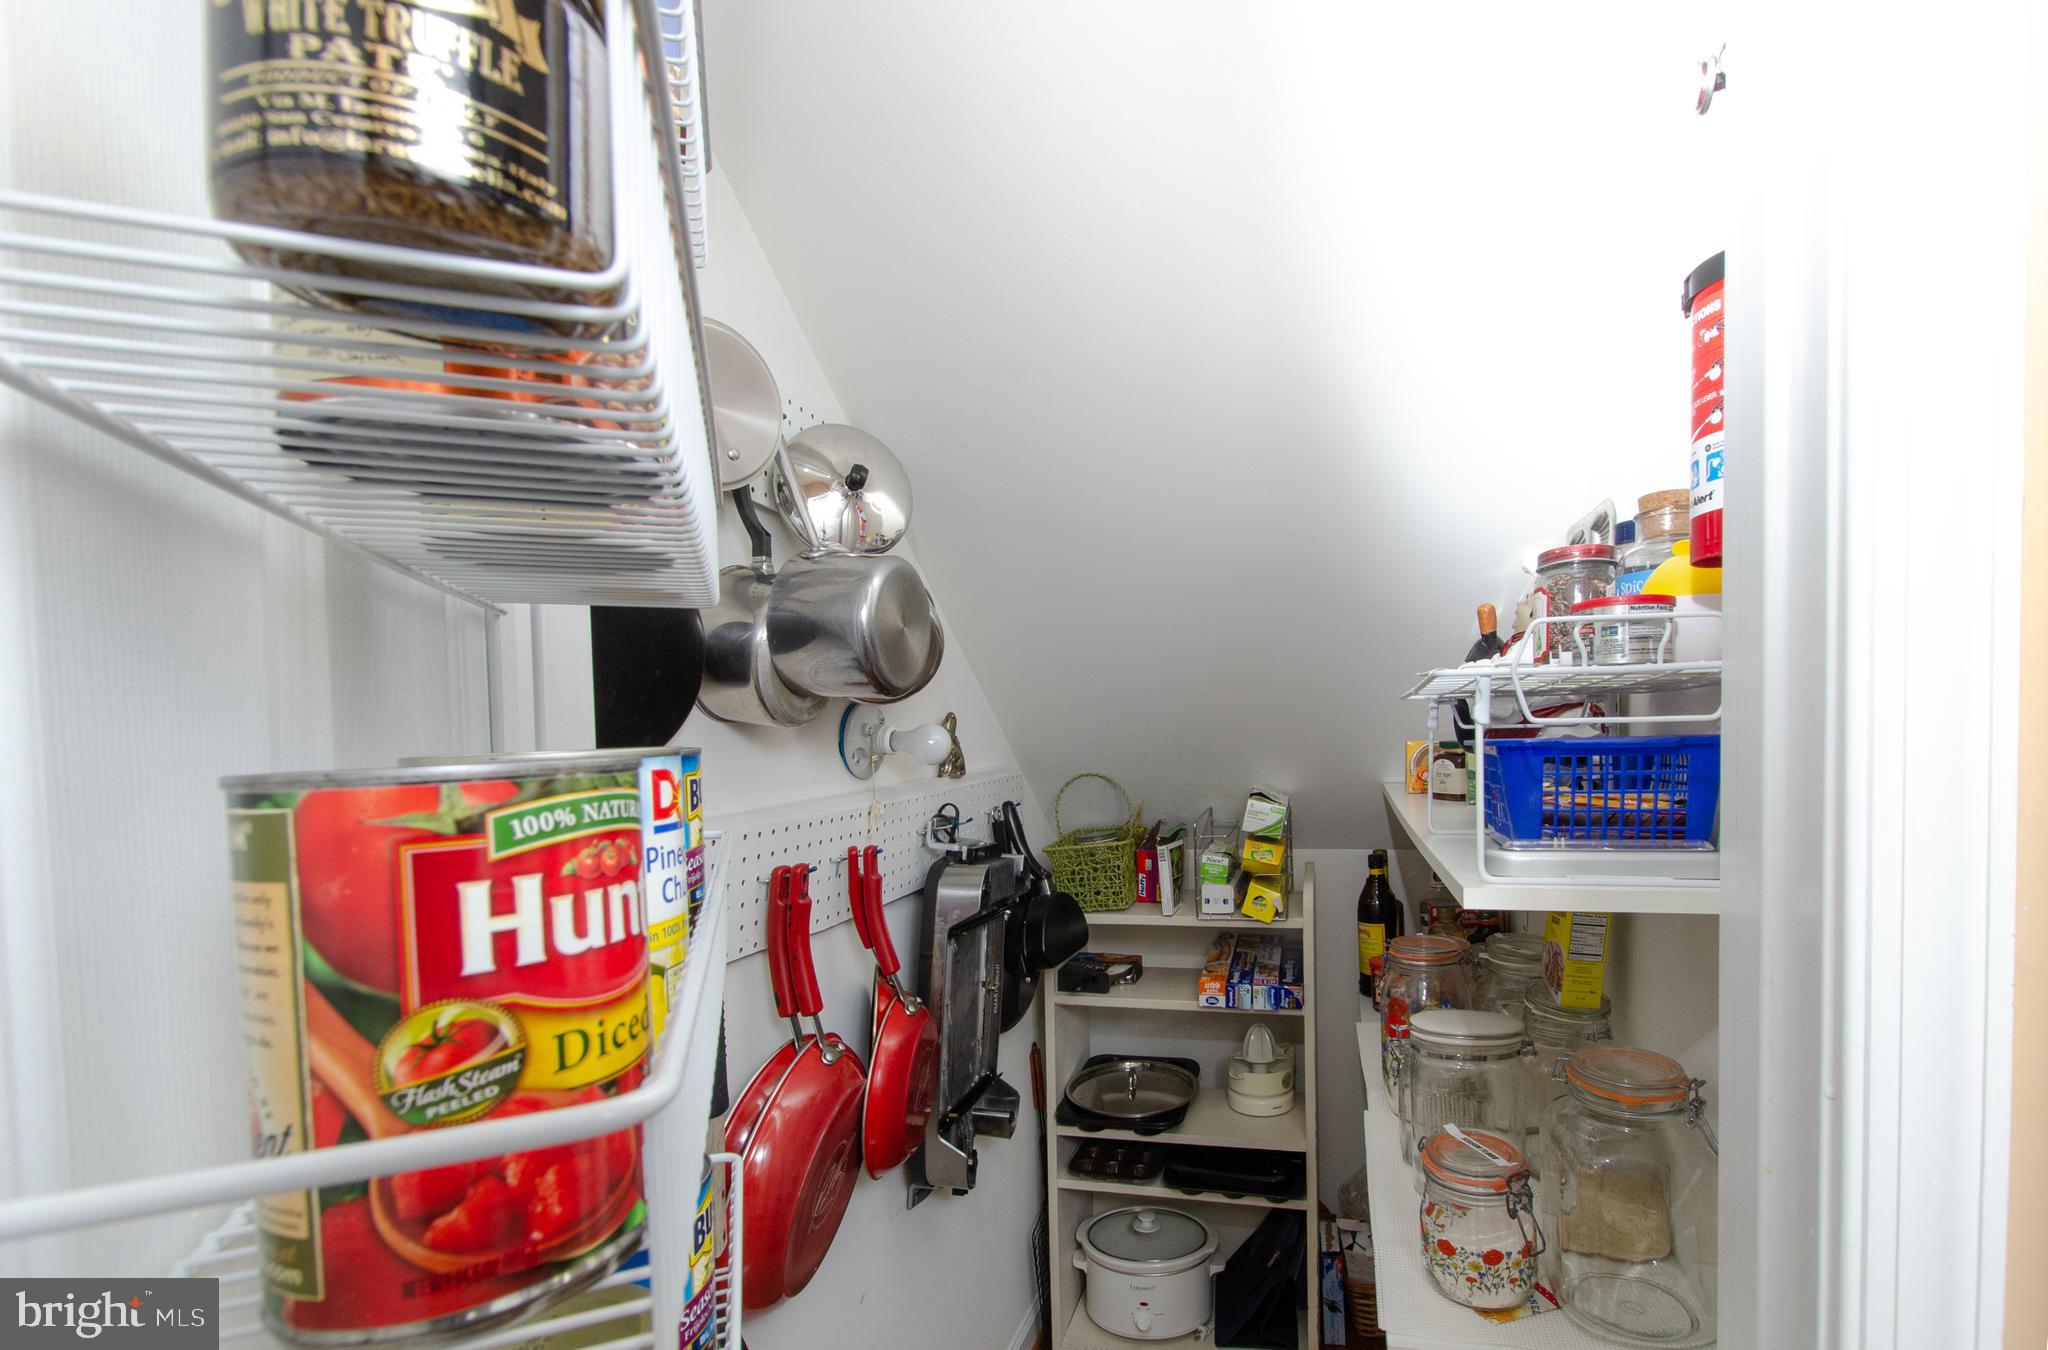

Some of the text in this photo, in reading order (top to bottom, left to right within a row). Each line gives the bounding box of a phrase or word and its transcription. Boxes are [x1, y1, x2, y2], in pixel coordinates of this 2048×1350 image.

[356, 0, 526, 97] TRUFFLE
[509, 804, 578, 841] 100%
[1139, 873, 1147, 896] Hefty
[662, 921, 681, 938] 100%
[552, 992, 650, 1075] Diced
[390, 1057, 520, 1115] Flash Steam
[424, 1084, 500, 1120] PEELED
